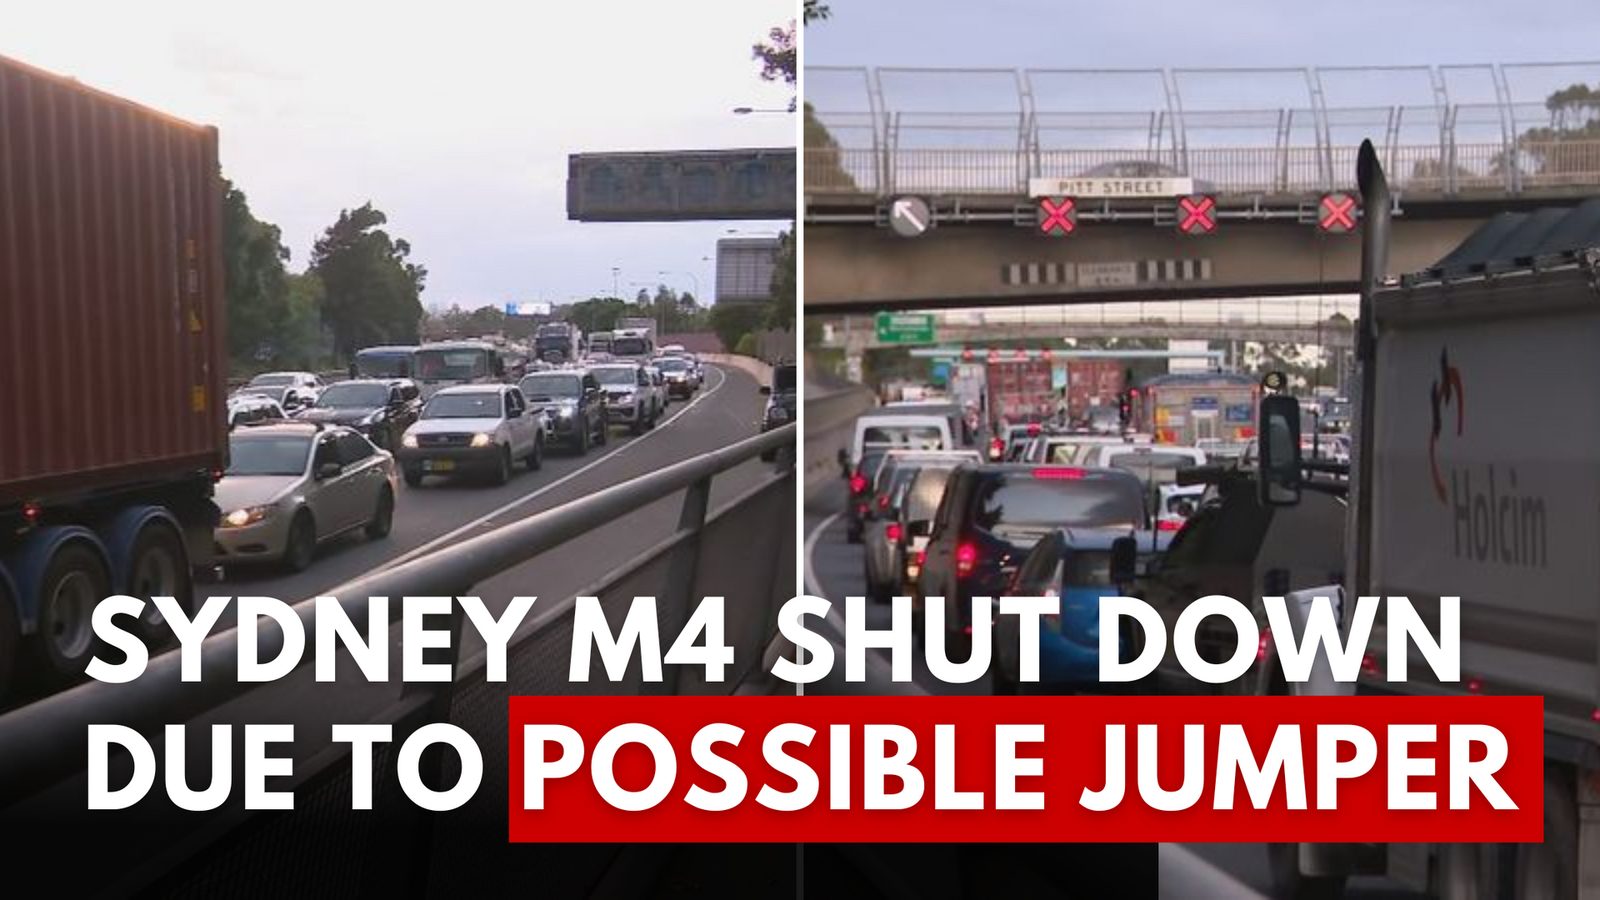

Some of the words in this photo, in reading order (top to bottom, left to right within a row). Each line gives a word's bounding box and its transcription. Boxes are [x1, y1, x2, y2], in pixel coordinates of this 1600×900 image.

[1059, 181, 1094, 193] PITT
[1103, 181, 1163, 193] STREET
[1452, 463, 1548, 567] Holcim
